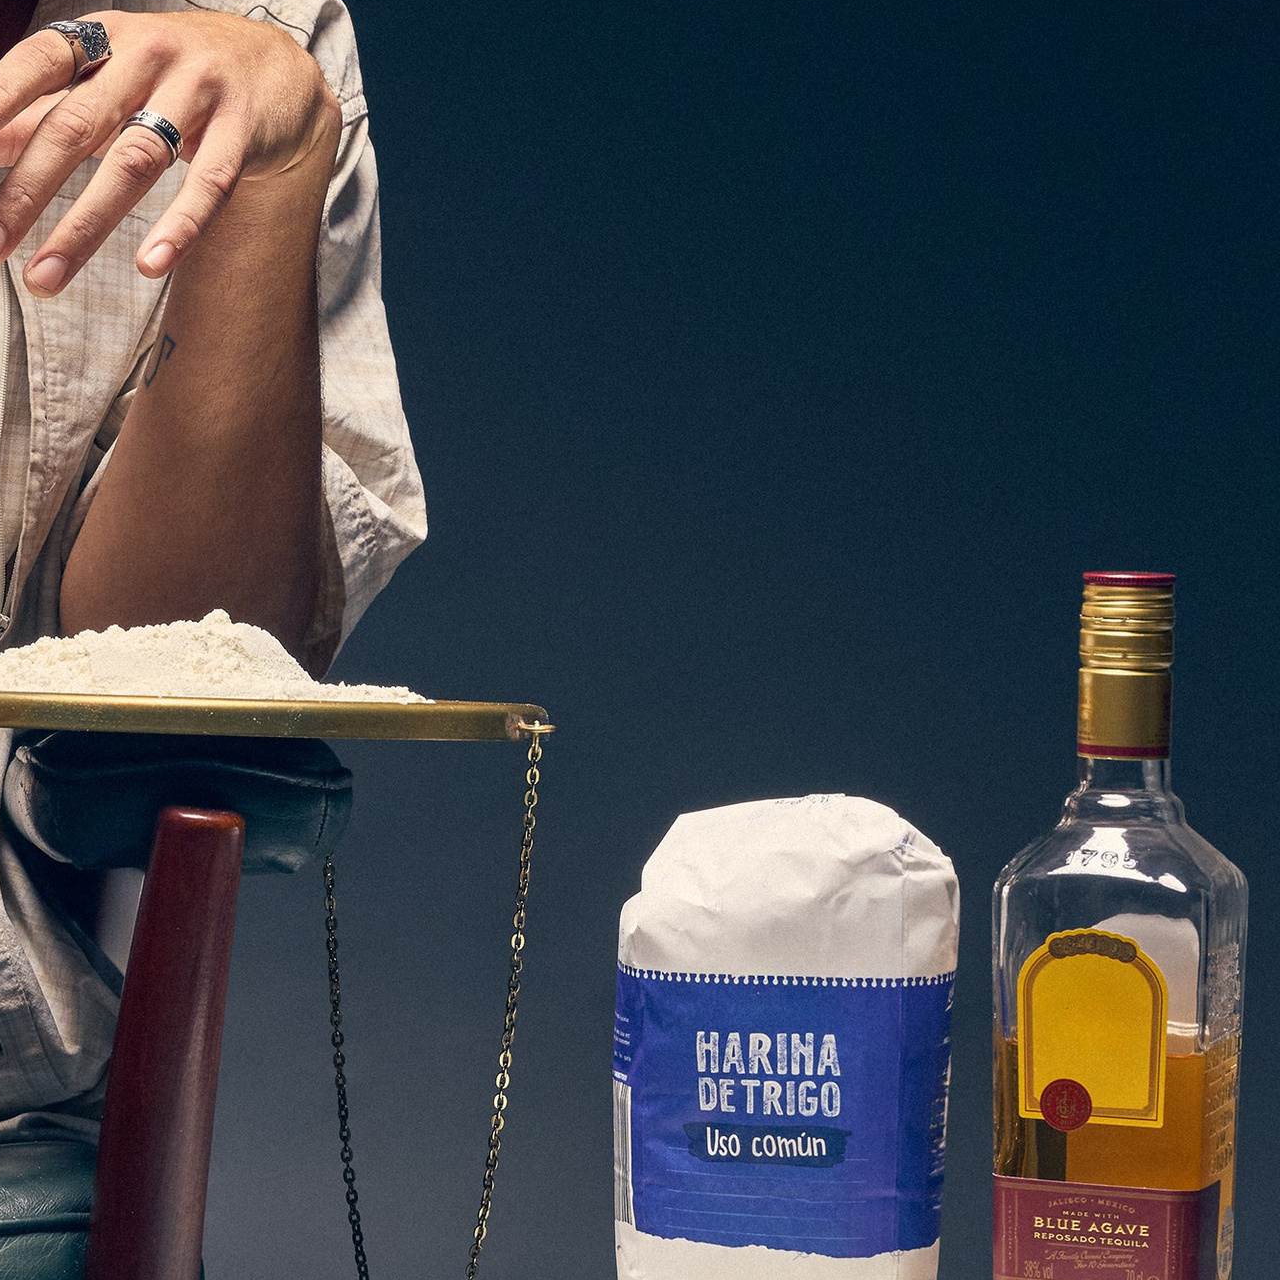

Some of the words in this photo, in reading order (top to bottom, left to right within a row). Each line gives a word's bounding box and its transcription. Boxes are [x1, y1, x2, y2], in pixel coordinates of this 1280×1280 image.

[1065, 849, 1138, 870] 1795
[696, 1031, 841, 1076] HARINA
[698, 1077, 736, 1113] DE
[740, 1079, 841, 1118] TRIGO
[706, 1126, 741, 1157] Uso
[751, 1132, 827, 1158] común
[1049, 1197, 1087, 1207] JALISCO
[1098, 1198, 1135, 1214] MEXICO
[1063, 1210, 1089, 1218] MADE
[1094, 1212, 1120, 1220] WITH
[1034, 1216, 1081, 1231] BLUE
[1088, 1221, 1150, 1237] AGAVE
[1034, 1232, 1096, 1243] REPOSADO
[1100, 1237, 1150, 1248] TEQUILA
[1024, 1261, 1040, 1278] 38%
[1042, 1263, 1054, 1279] vol
